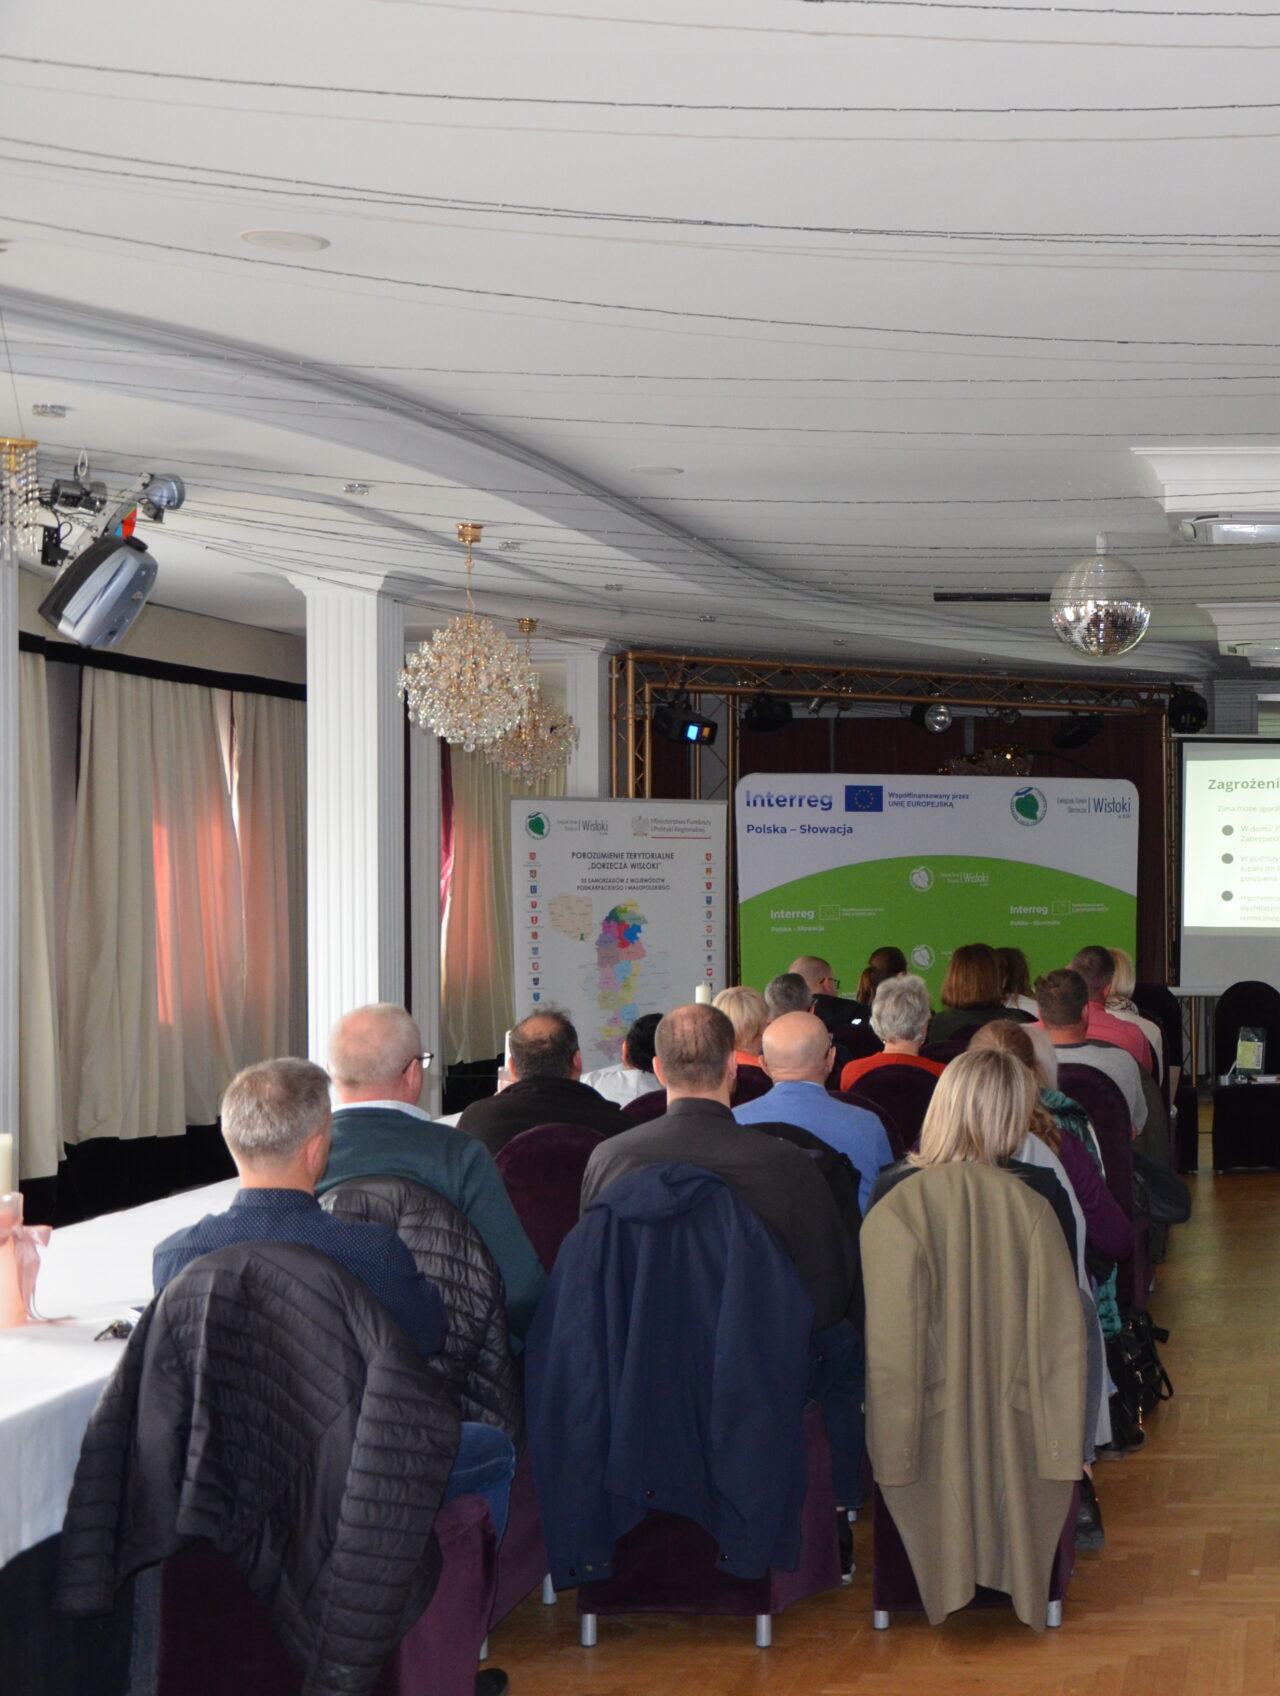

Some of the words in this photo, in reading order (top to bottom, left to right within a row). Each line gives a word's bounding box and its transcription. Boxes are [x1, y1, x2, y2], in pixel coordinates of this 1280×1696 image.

[745, 789, 833, 811] Interreg
[888, 792, 950, 800] Współfinansowany
[1092, 796, 1131, 813] Wisłoki
[582, 819, 608, 832] Wisłoki
[746, 824, 787, 834] Polska
[799, 824, 854, 836] Słowacja
[571, 851, 625, 860] POROZUMIENIE
[626, 851, 675, 860] TERYTORIALNE
[770, 909, 815, 920] Interreg
[1009, 905, 1049, 915] Interreg
